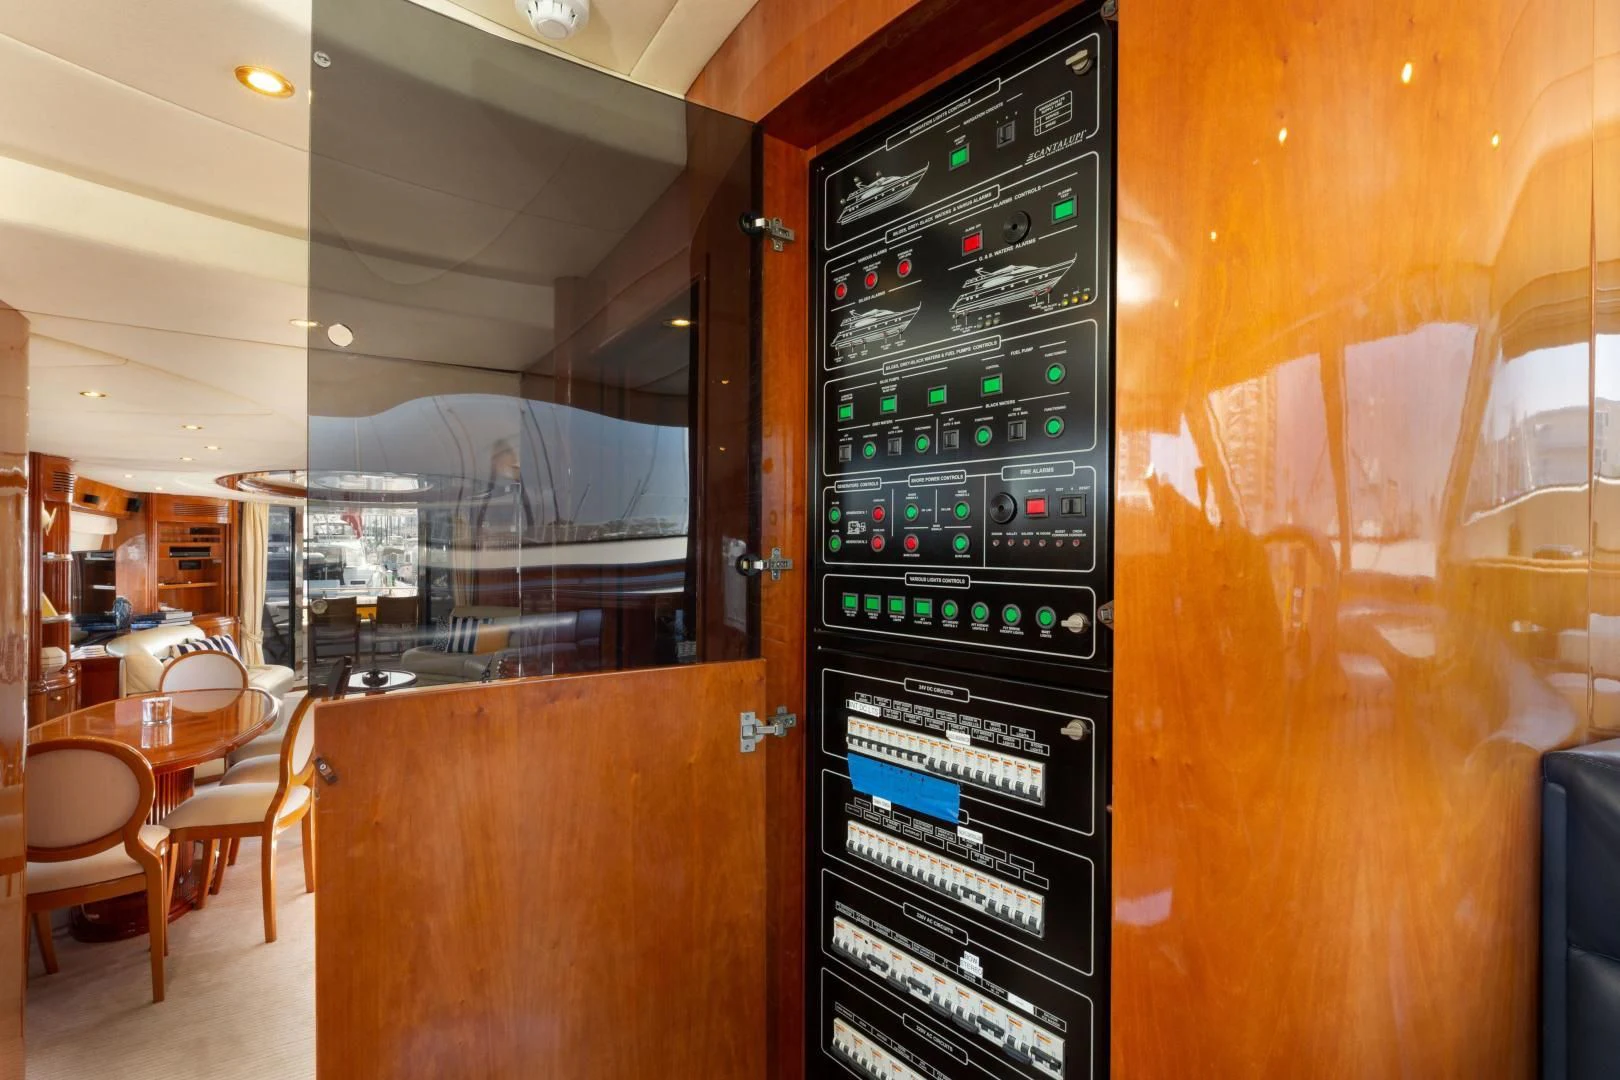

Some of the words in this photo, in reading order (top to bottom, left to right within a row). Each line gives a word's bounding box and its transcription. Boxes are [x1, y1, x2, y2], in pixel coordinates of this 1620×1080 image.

[993, 196, 1013, 209] ALARMS
[1014, 185, 1042, 201] CONTROLS
[994, 245, 1014, 257] WATERS
[1015, 238, 1036, 250] ALARMS
[972, 340, 997, 351] CONTROLS
[933, 1035, 953, 1052] CIRCUITS
